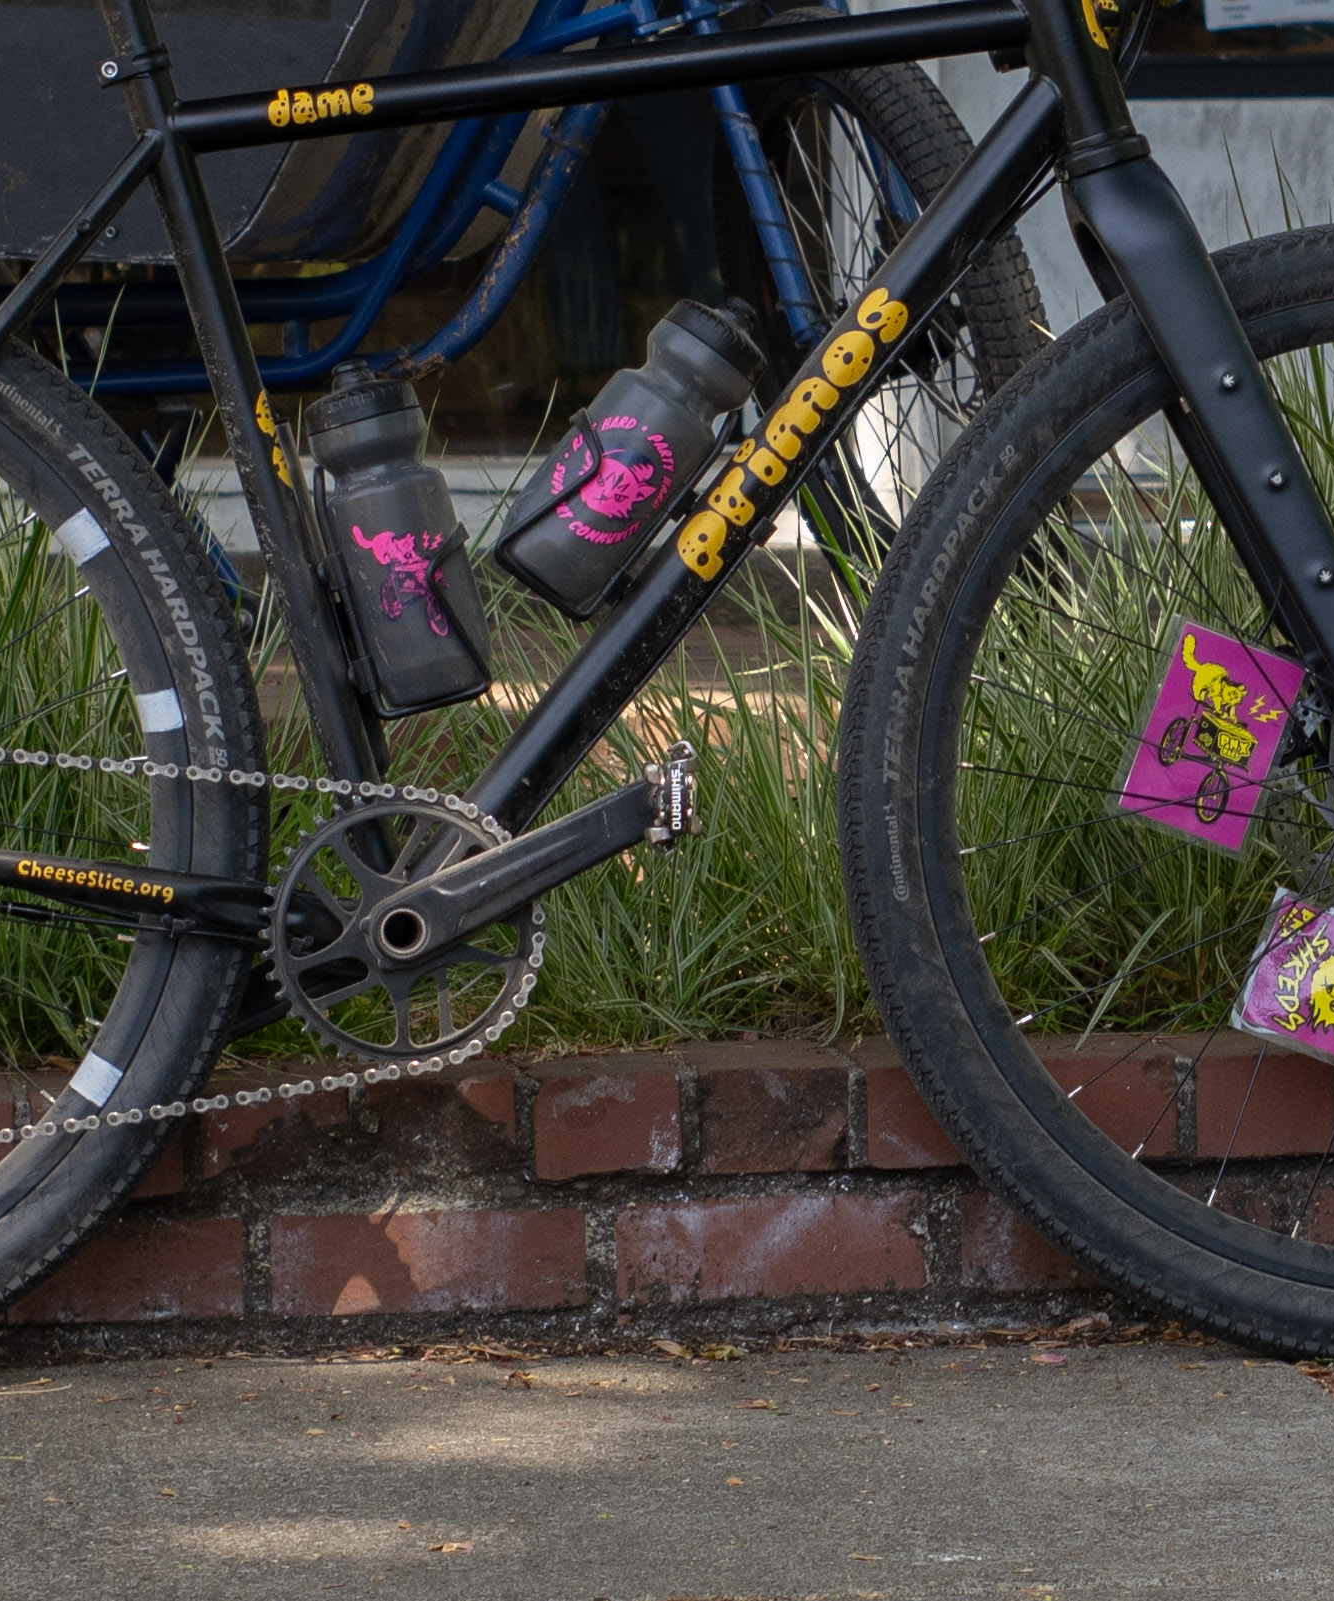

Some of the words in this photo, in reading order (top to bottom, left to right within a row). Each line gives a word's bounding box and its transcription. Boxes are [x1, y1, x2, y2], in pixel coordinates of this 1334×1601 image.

[268, 83, 375, 127] dame
[601, 416, 638, 431] HARD
[647, 433, 675, 472] PARTY
[568, 520, 641, 545] COMMUNITY
[67, 442, 149, 546] TERRA
[141, 549, 226, 741] HARDPACK
[215, 747, 229, 769] 50
[882, 665, 915, 786] TERRA
[902, 466, 1005, 659] HARDPACK
[671, 769, 683, 830] SHIMANO
[17, 859, 175, 903] CheeseSlice.org
[885, 815, 910, 902] Continental
[1272, 921, 1330, 1032] SHREDS
